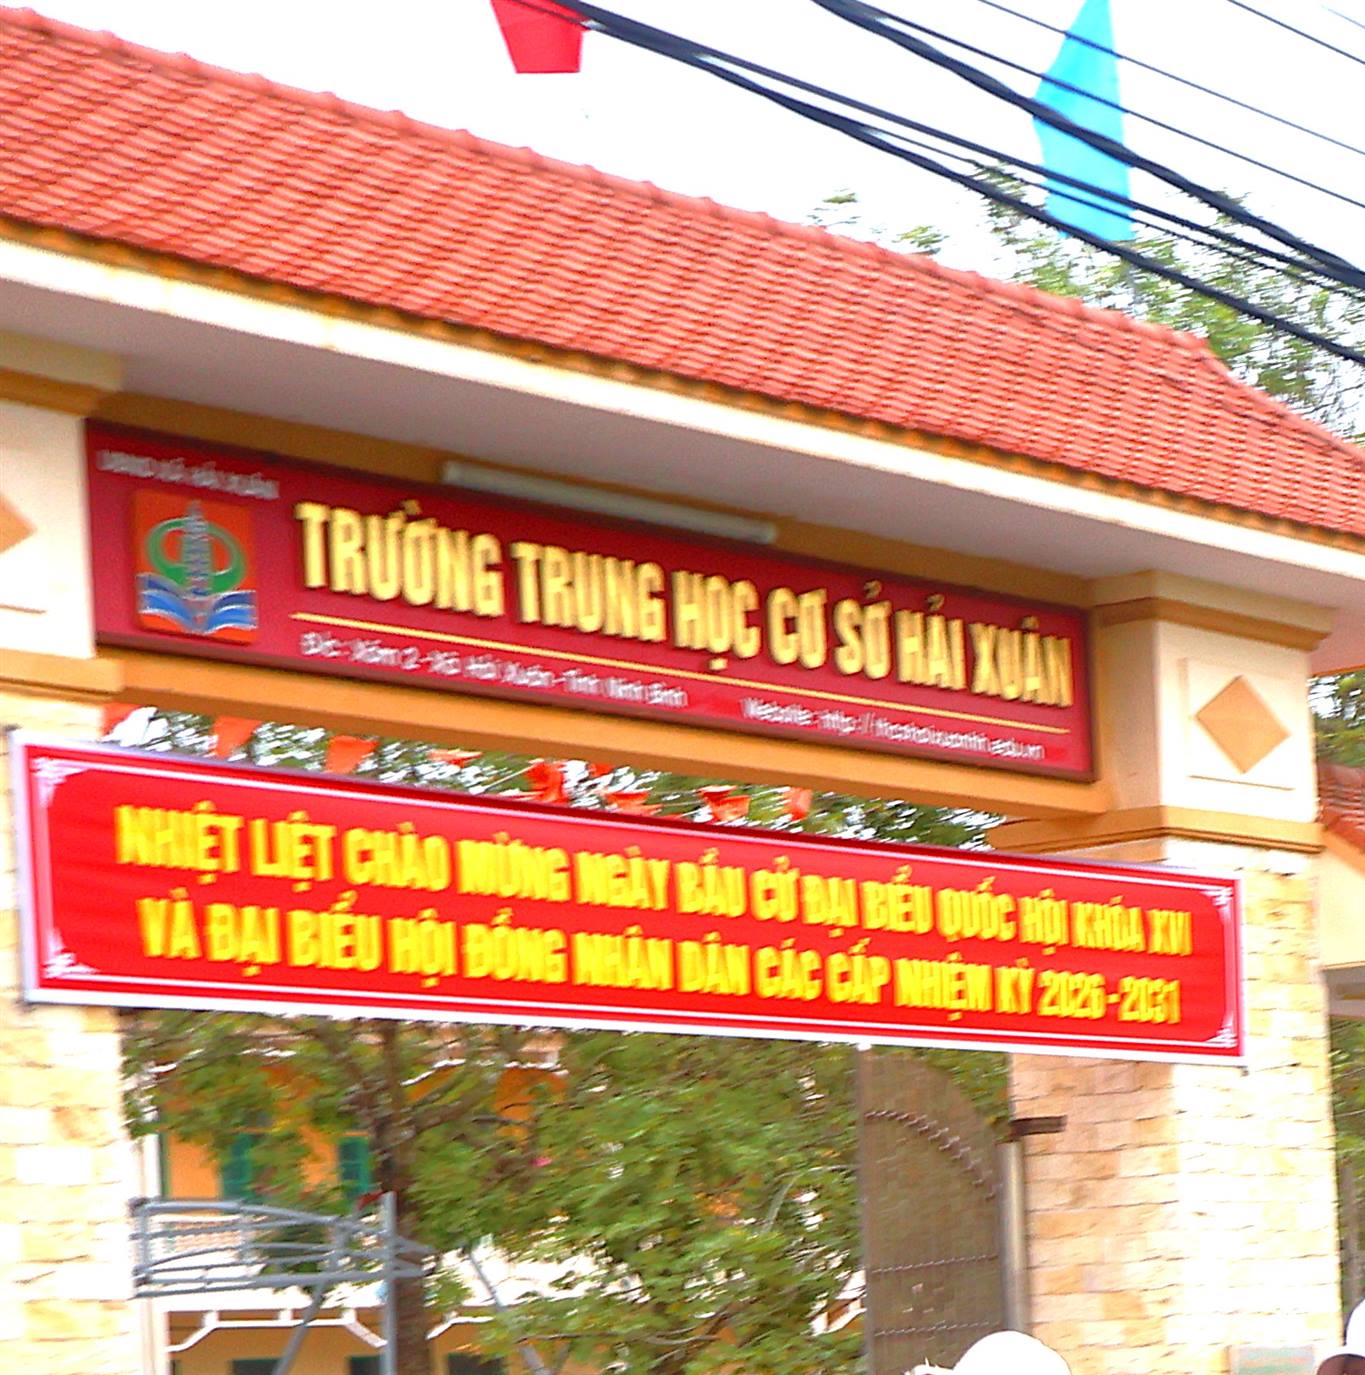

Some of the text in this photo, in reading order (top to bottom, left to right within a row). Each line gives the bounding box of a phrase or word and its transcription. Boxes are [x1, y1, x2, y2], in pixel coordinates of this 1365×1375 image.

[295, 500, 1073, 707] TRƯỜNG TRUNG HỌC CƠ SỞ HẢI XUÂN
[115, 801, 1192, 957] NHIỆT LIỆT CHÀO MỪNG NGÀY BẦU CỬ ĐẠI BIỂU QUỐC HỘI KHÓA XVI
[137, 887, 201, 960] VÀ
[204, 902, 281, 977] ĐẠI
[286, 890, 383, 971] BIỂU
[387, 908, 457, 988] HỘI
[462, 908, 567, 984] ĐỒNG
[571, 925, 673, 991] NHÂN
[677, 931, 749, 996] DÂN
[754, 938, 823, 1001] CÁC
[826, 938, 891, 1004] CẤP
[894, 952, 993, 1021] NHIỆM
[995, 957, 1035, 1014] KỲ
